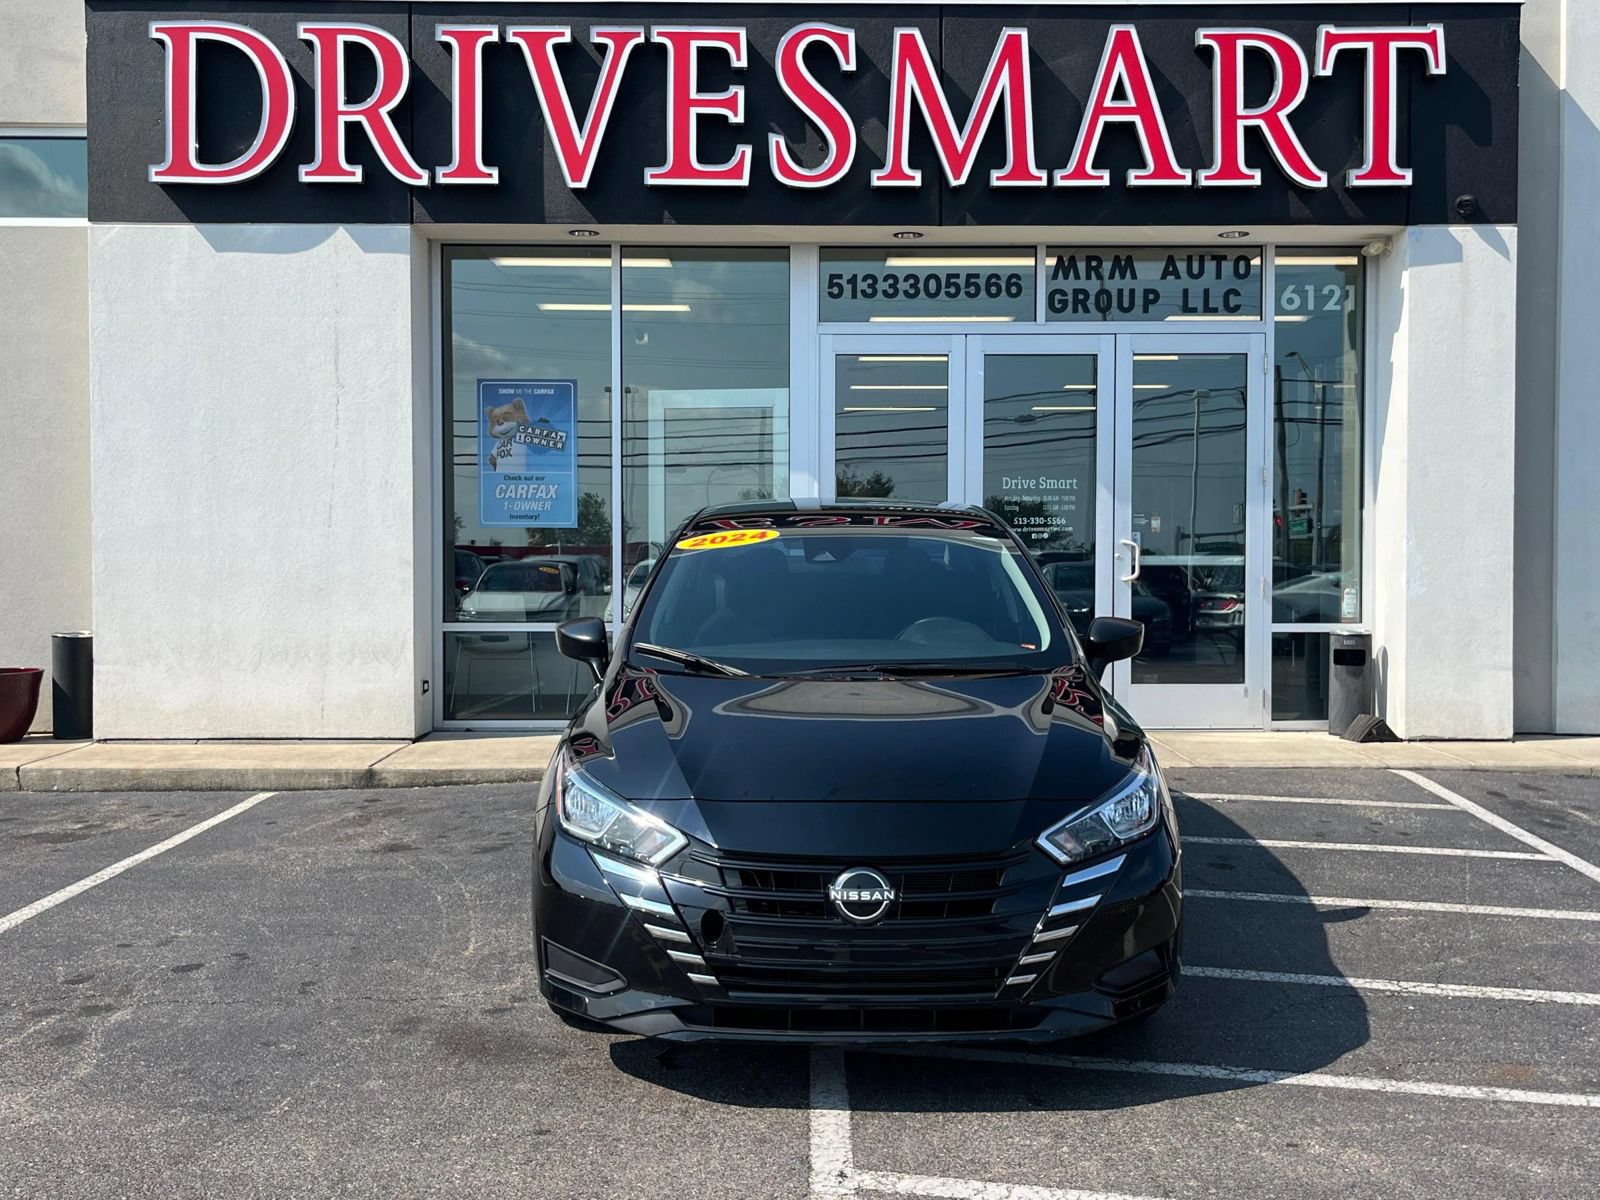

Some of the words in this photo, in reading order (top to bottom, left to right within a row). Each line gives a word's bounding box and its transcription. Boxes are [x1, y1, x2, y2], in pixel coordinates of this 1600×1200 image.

[148, 21, 1447, 190] DRIVESMART
[1051, 254, 1138, 280] MRM
[1160, 254, 1252, 280] AUTO
[827, 273, 1023, 300] 5133305566
[1047, 288, 1161, 314] GROUP
[1182, 288, 1242, 313] LLC
[1280, 284, 1356, 311] 6121
[519, 425, 566, 442] CARFAX
[496, 439, 513, 450] CAR
[525, 436, 563, 449] OWNER
[496, 448, 513, 459] FOX
[1002, 476, 1037, 489] Drive
[1039, 477, 1078, 489] Smart
[495, 484, 558, 499] CARFAX
[503, 501, 552, 511] 1-OWNER
[1013, 517, 1066, 525] 513-330-5566
[690, 532, 768, 548] 2024
[830, 890, 895, 901] NISSAN
